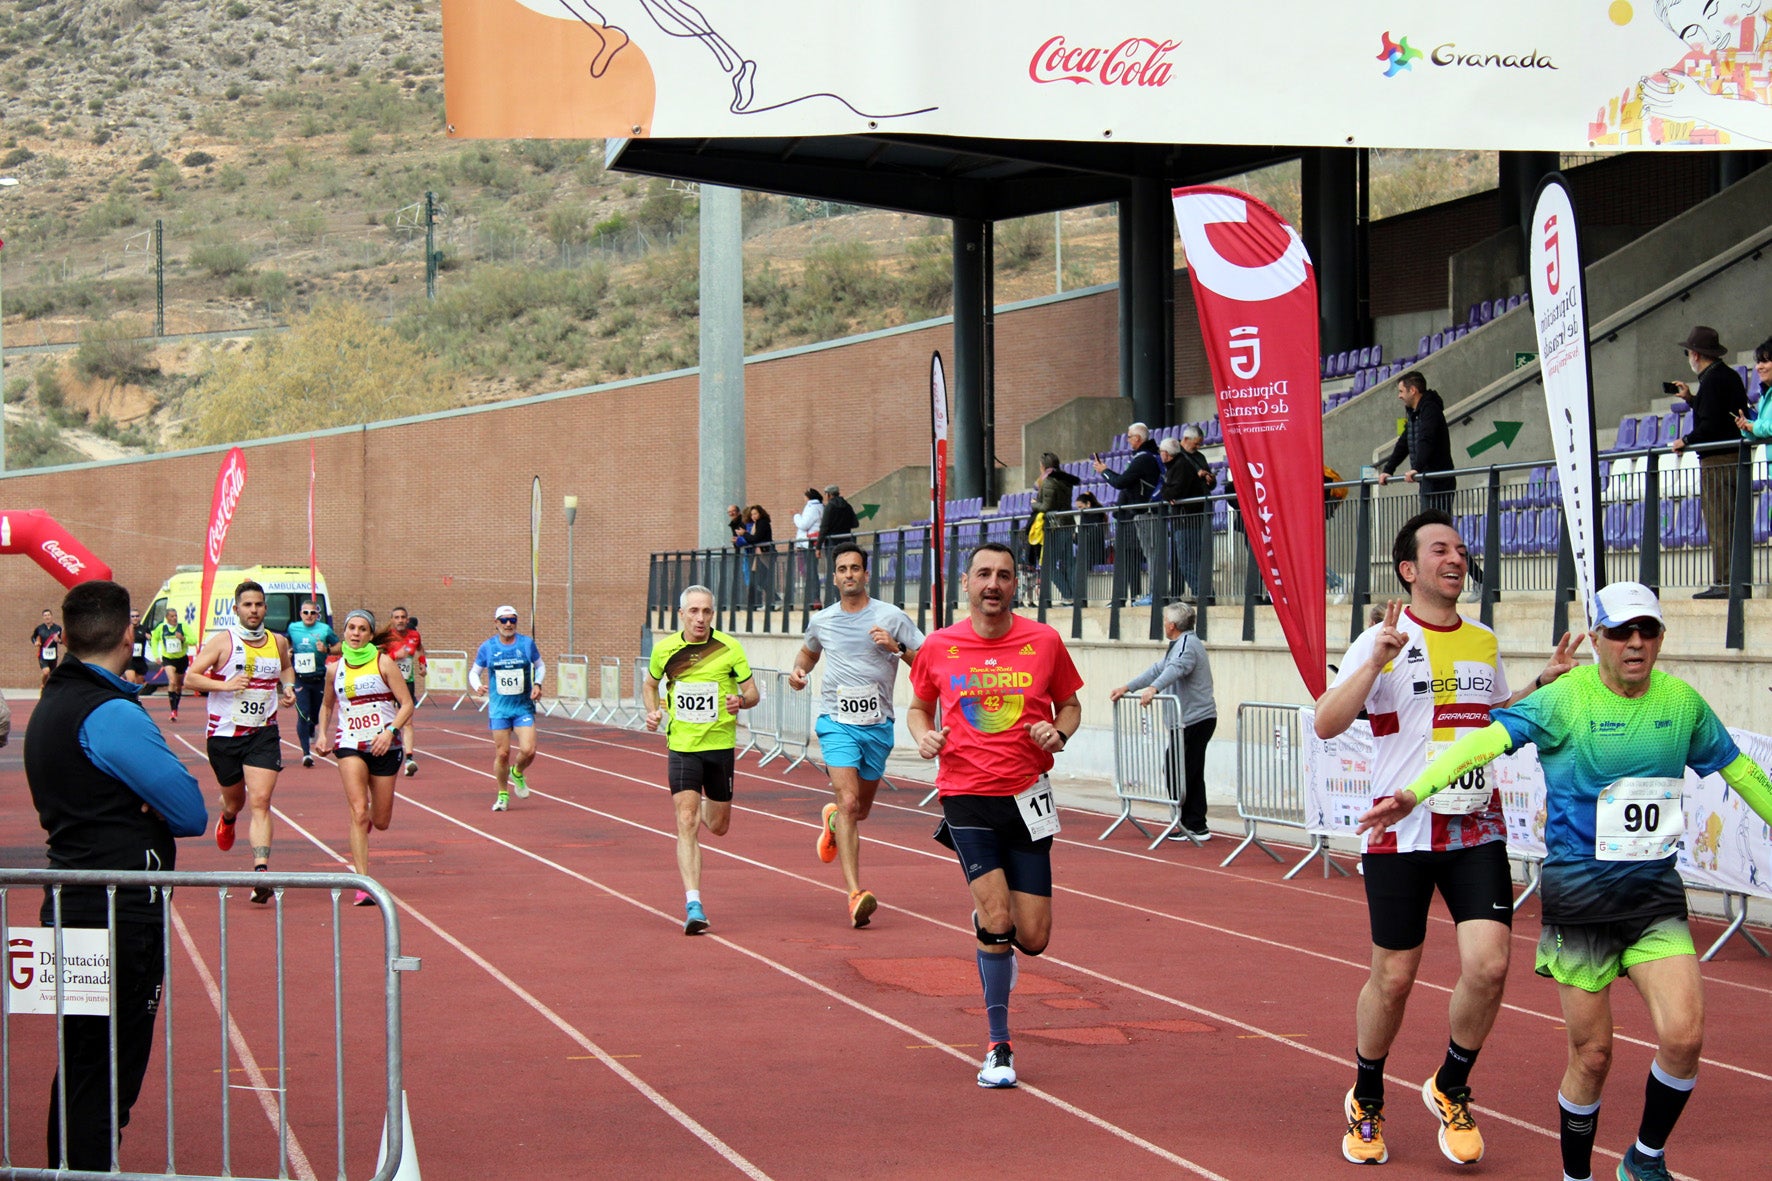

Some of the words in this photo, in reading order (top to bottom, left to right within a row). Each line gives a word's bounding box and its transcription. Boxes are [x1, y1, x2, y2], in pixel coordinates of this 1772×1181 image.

[1029, 35, 1184, 87] Coca-Cola
[1431, 42, 1559, 70] Granada
[208, 452, 246, 565] Coca-Cola
[42, 540, 86, 575] Coca-Cola
[214, 598, 235, 615] UV
[213, 616, 236, 626] MOVIL
[501, 677, 519, 686] 661
[950, 671, 1033, 691] MADRID
[240, 701, 266, 714] 395
[677, 695, 714, 710] 3021
[840, 697, 877, 713] 3096
[983, 695, 1000, 707] 42
[347, 713, 380, 730] 2089
[1437, 713, 1481, 721] GRANADA
[1624, 803, 1660, 832] 90
[40, 970, 55, 984] de
